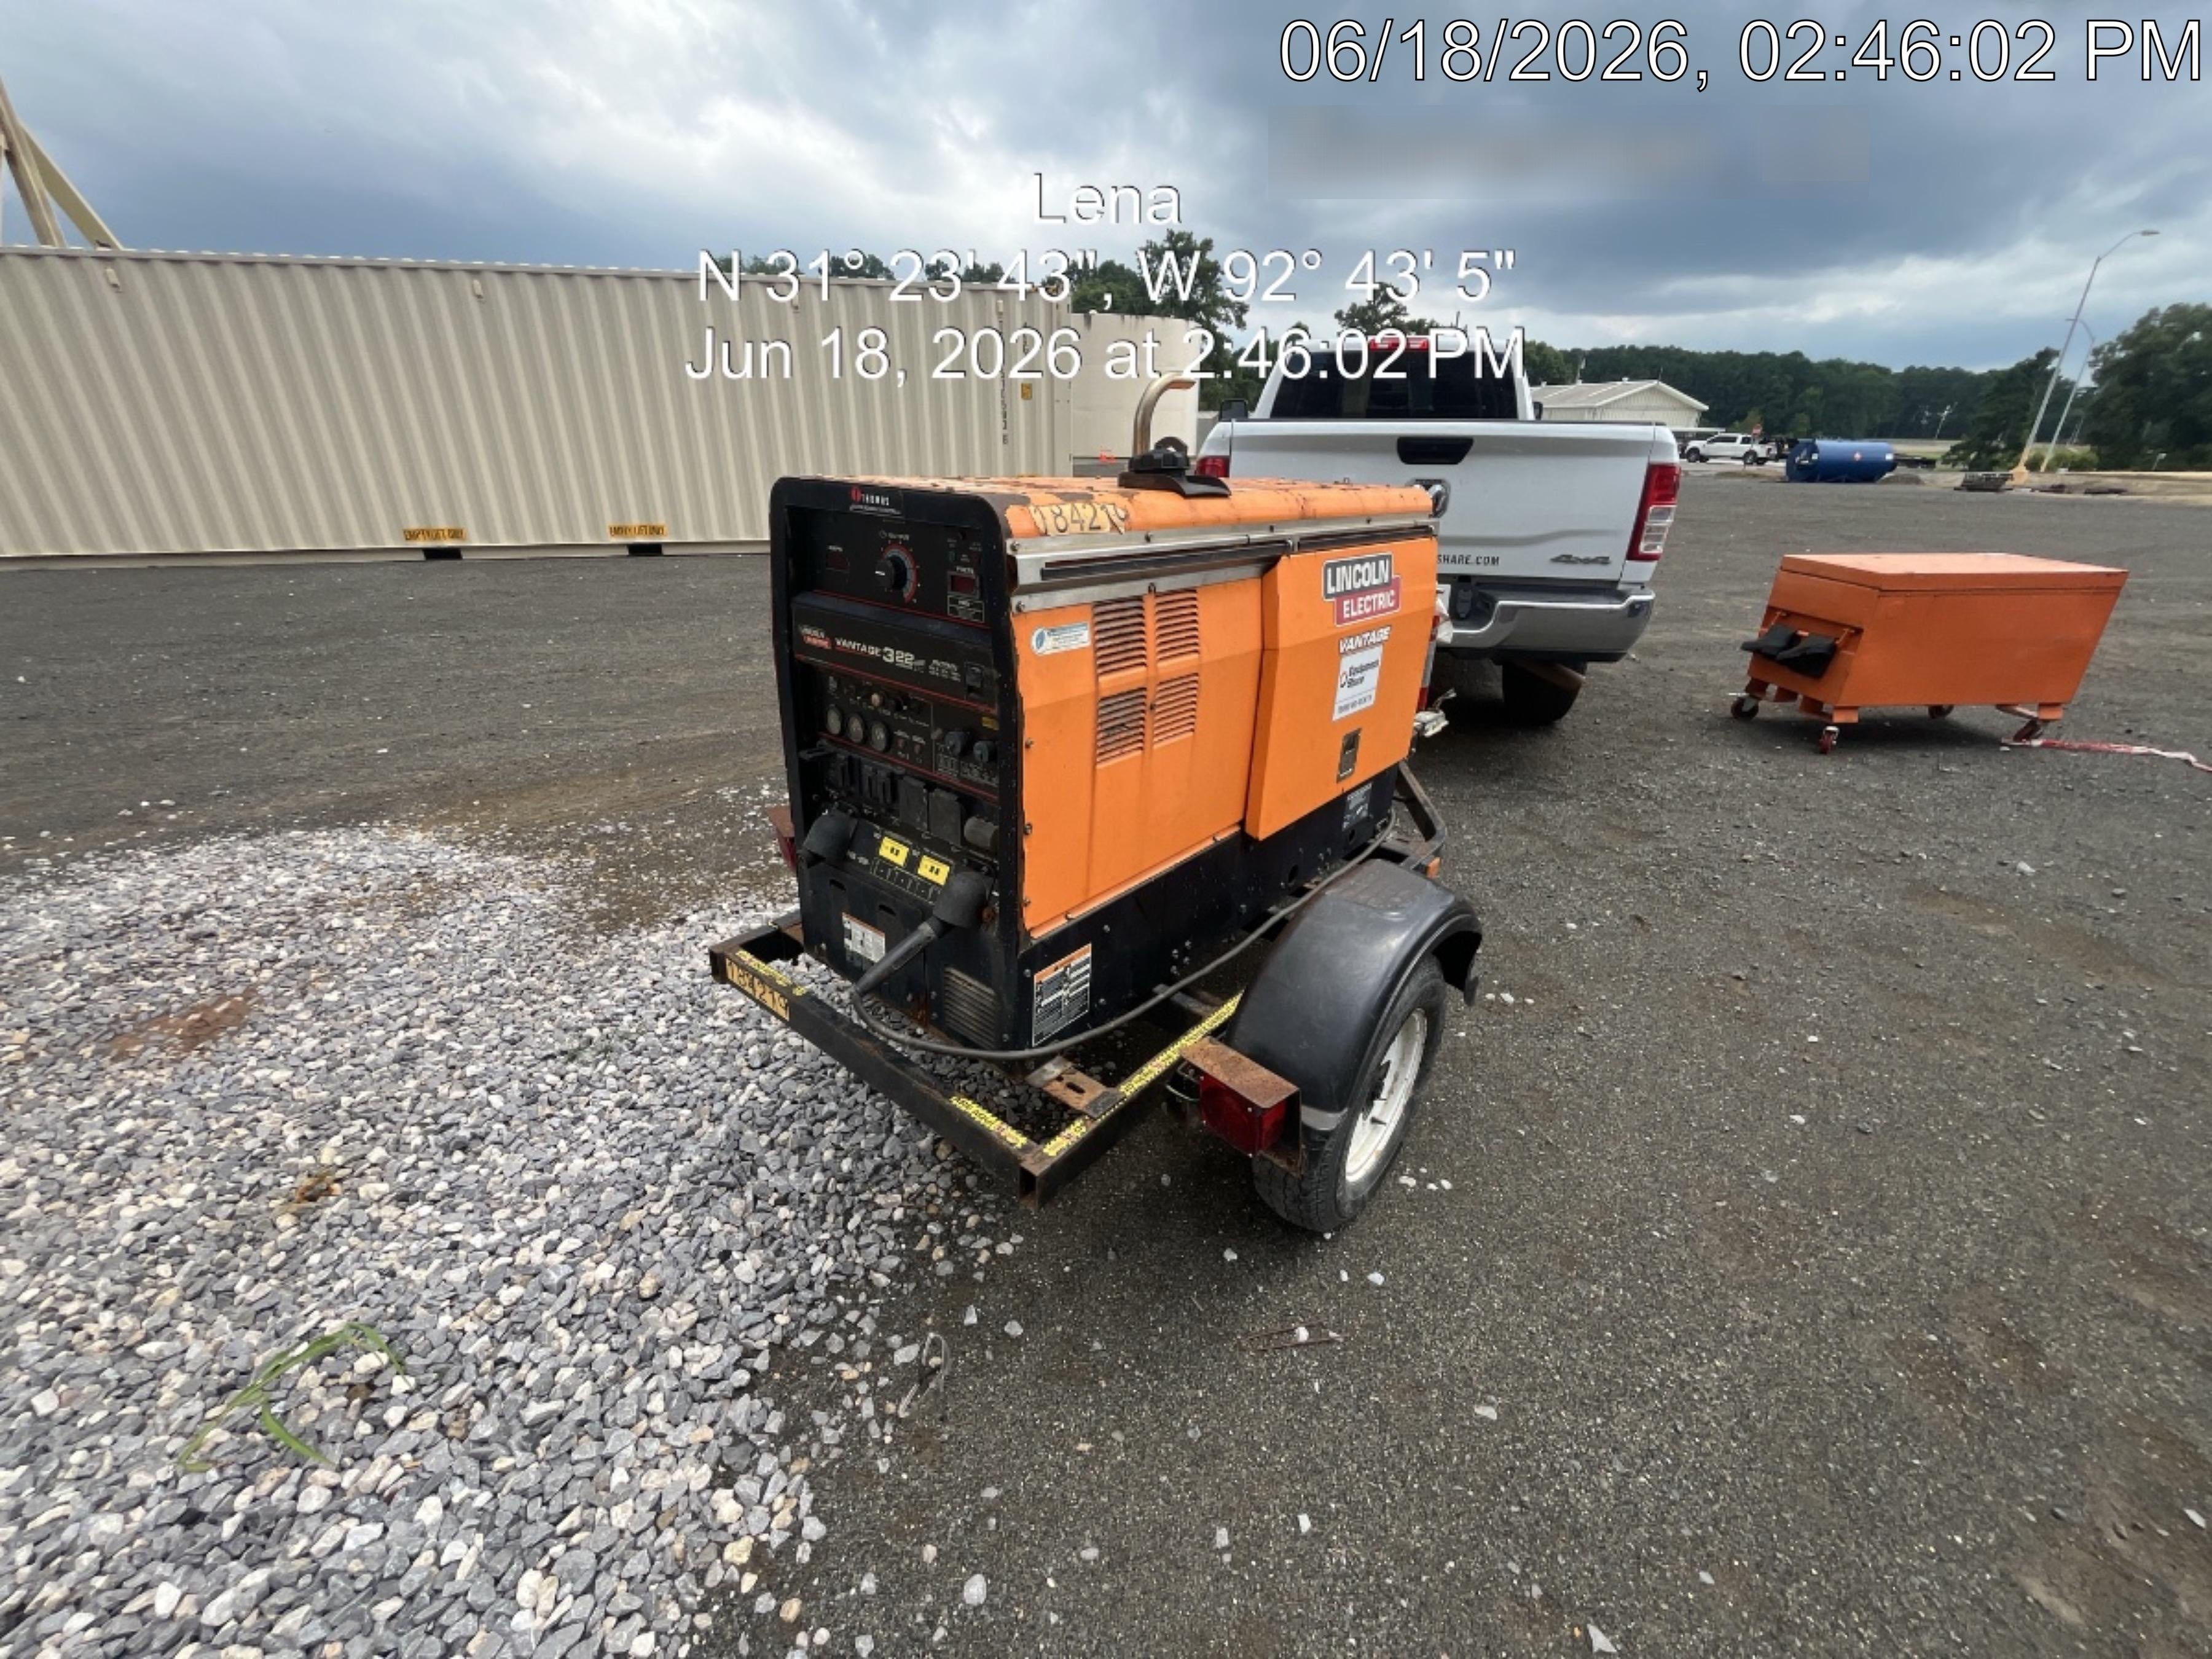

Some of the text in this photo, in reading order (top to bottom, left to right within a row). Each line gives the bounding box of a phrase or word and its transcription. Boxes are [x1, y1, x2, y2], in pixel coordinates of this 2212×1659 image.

[1438, 554, 1499, 566] SHARE.COM
[1326, 560, 1390, 594] LINCOLN
[1342, 589, 1395, 619] ELECTRIC
[834, 637, 883, 657] VANTAGE
[882, 646, 915, 664] 322
[1339, 626, 1392, 654] VANTAGE
